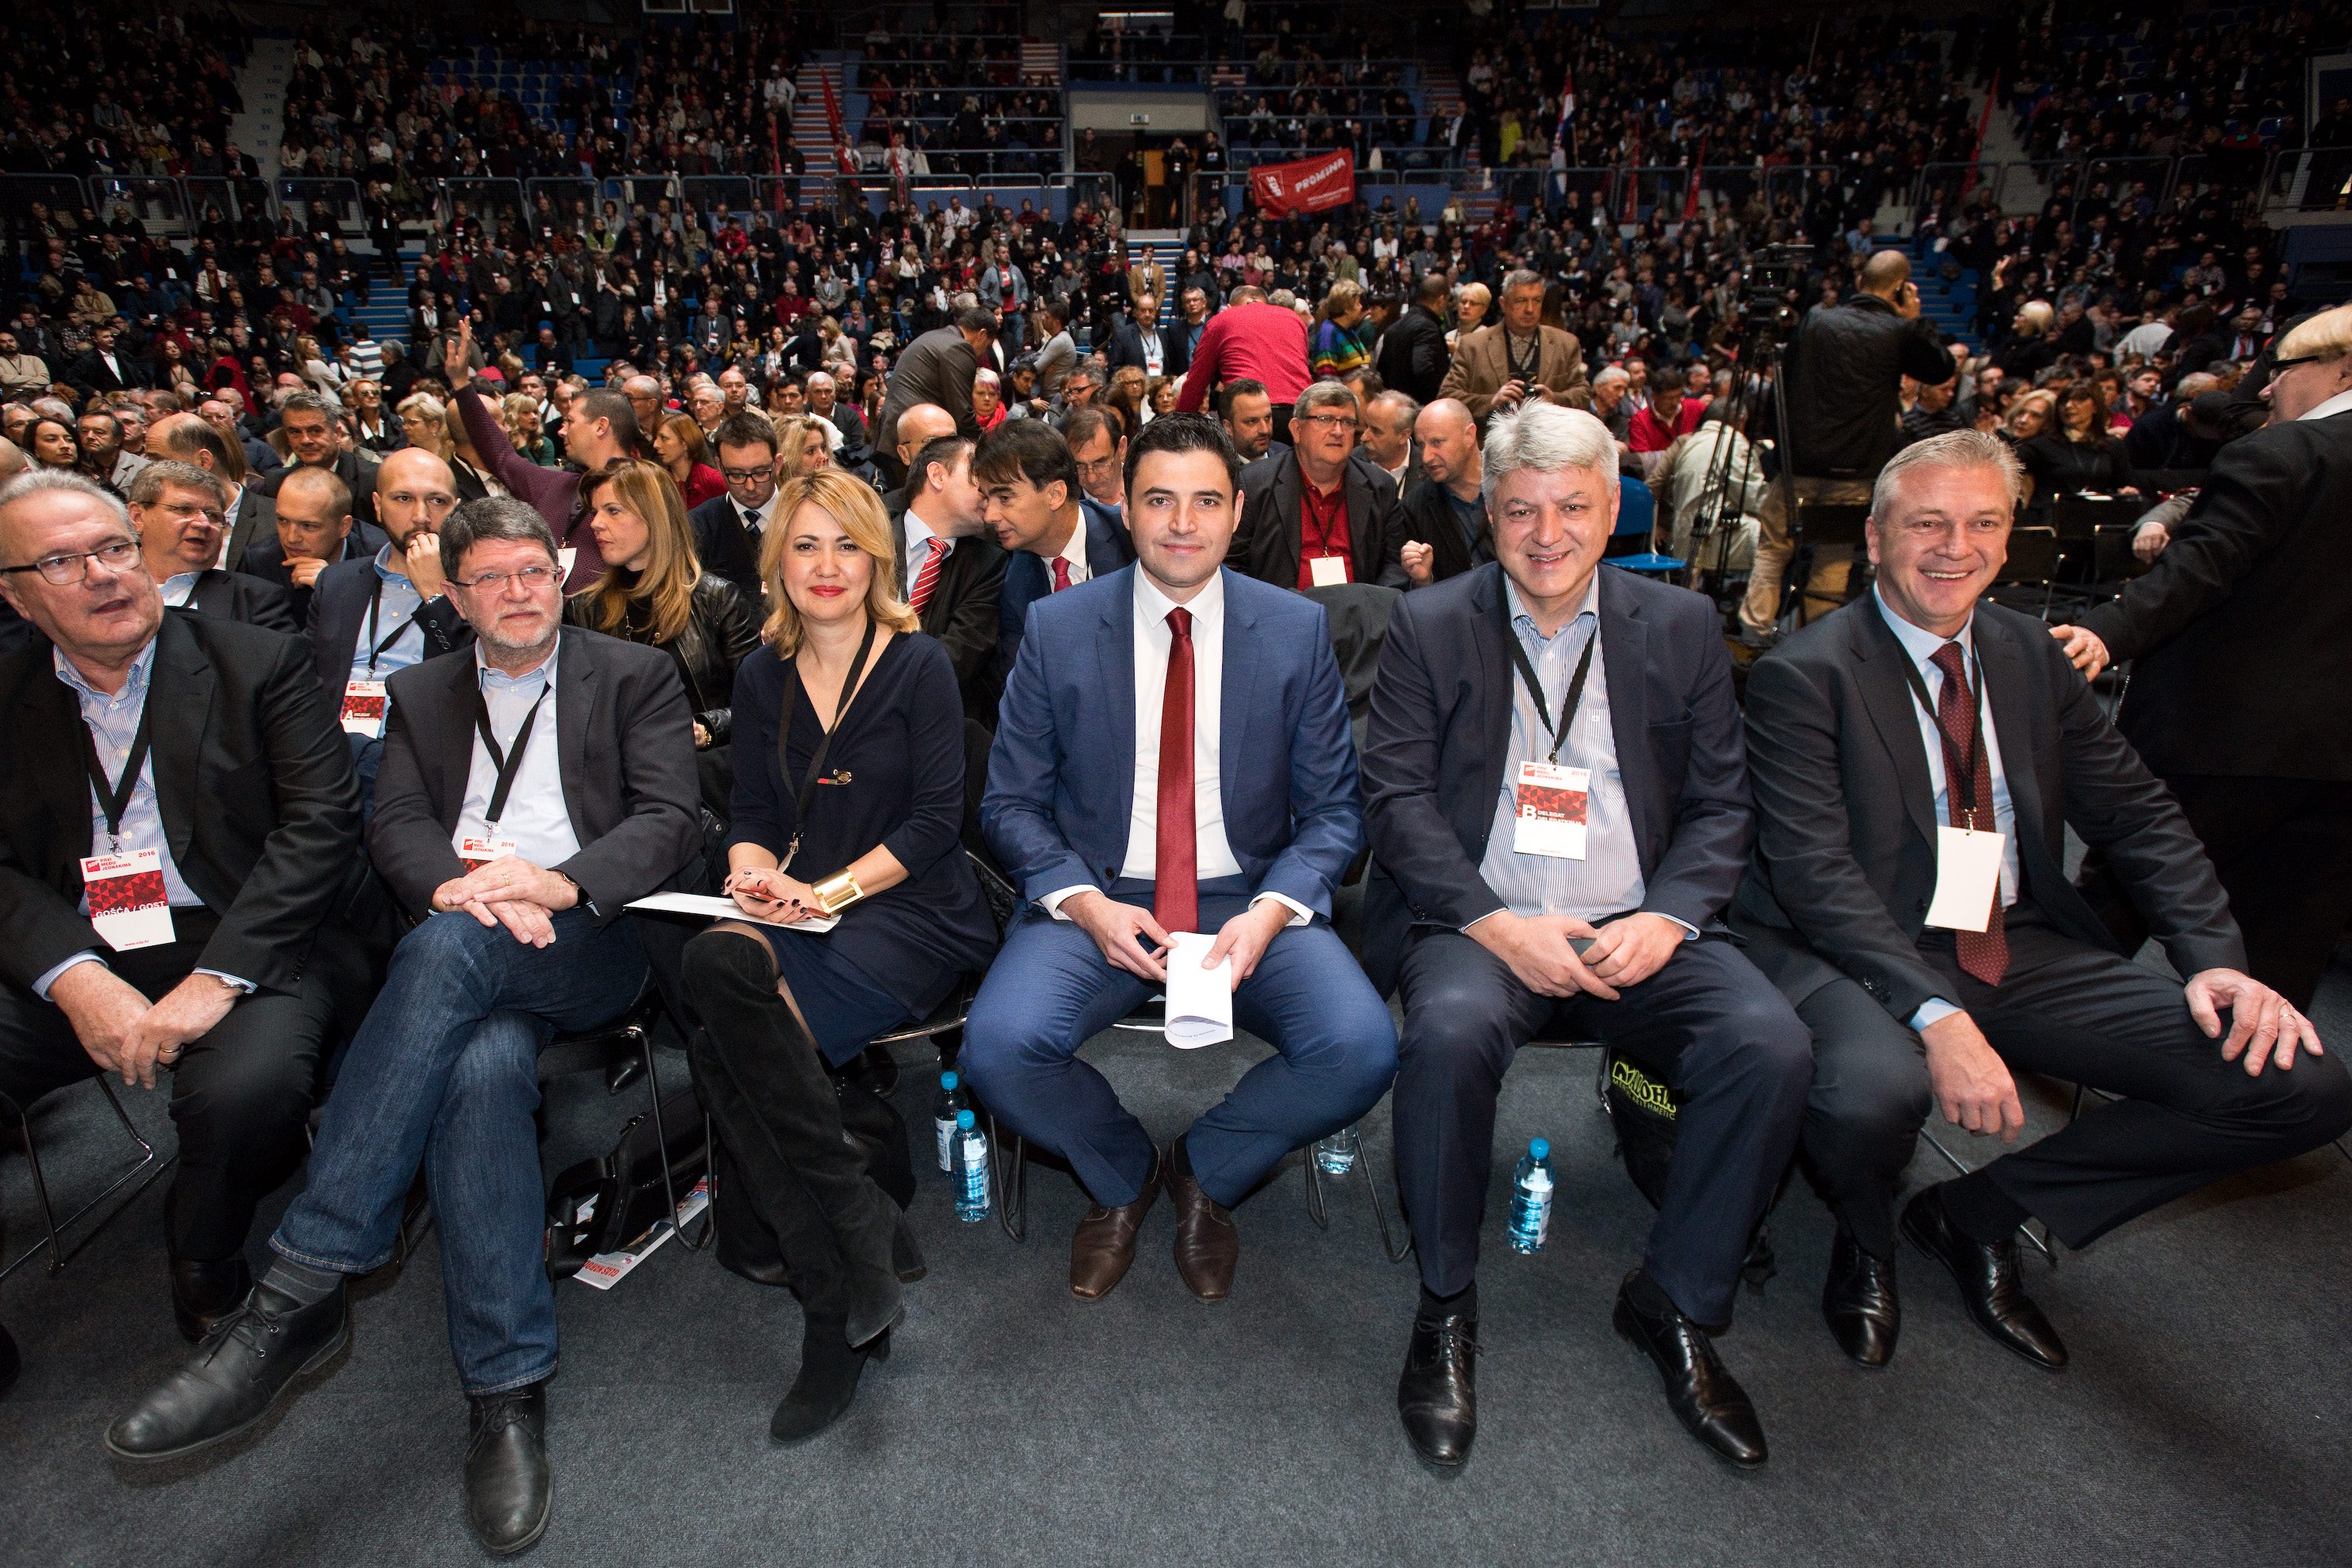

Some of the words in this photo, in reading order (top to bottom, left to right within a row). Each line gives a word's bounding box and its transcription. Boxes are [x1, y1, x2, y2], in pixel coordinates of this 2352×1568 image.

[1295, 158, 1345, 192] PROMINA
[1523, 804, 1537, 819] B
[96, 907, 131, 918] GOŠĆA
[139, 901, 165, 911] GOST
[602, 1267, 619, 1277] GLAS
